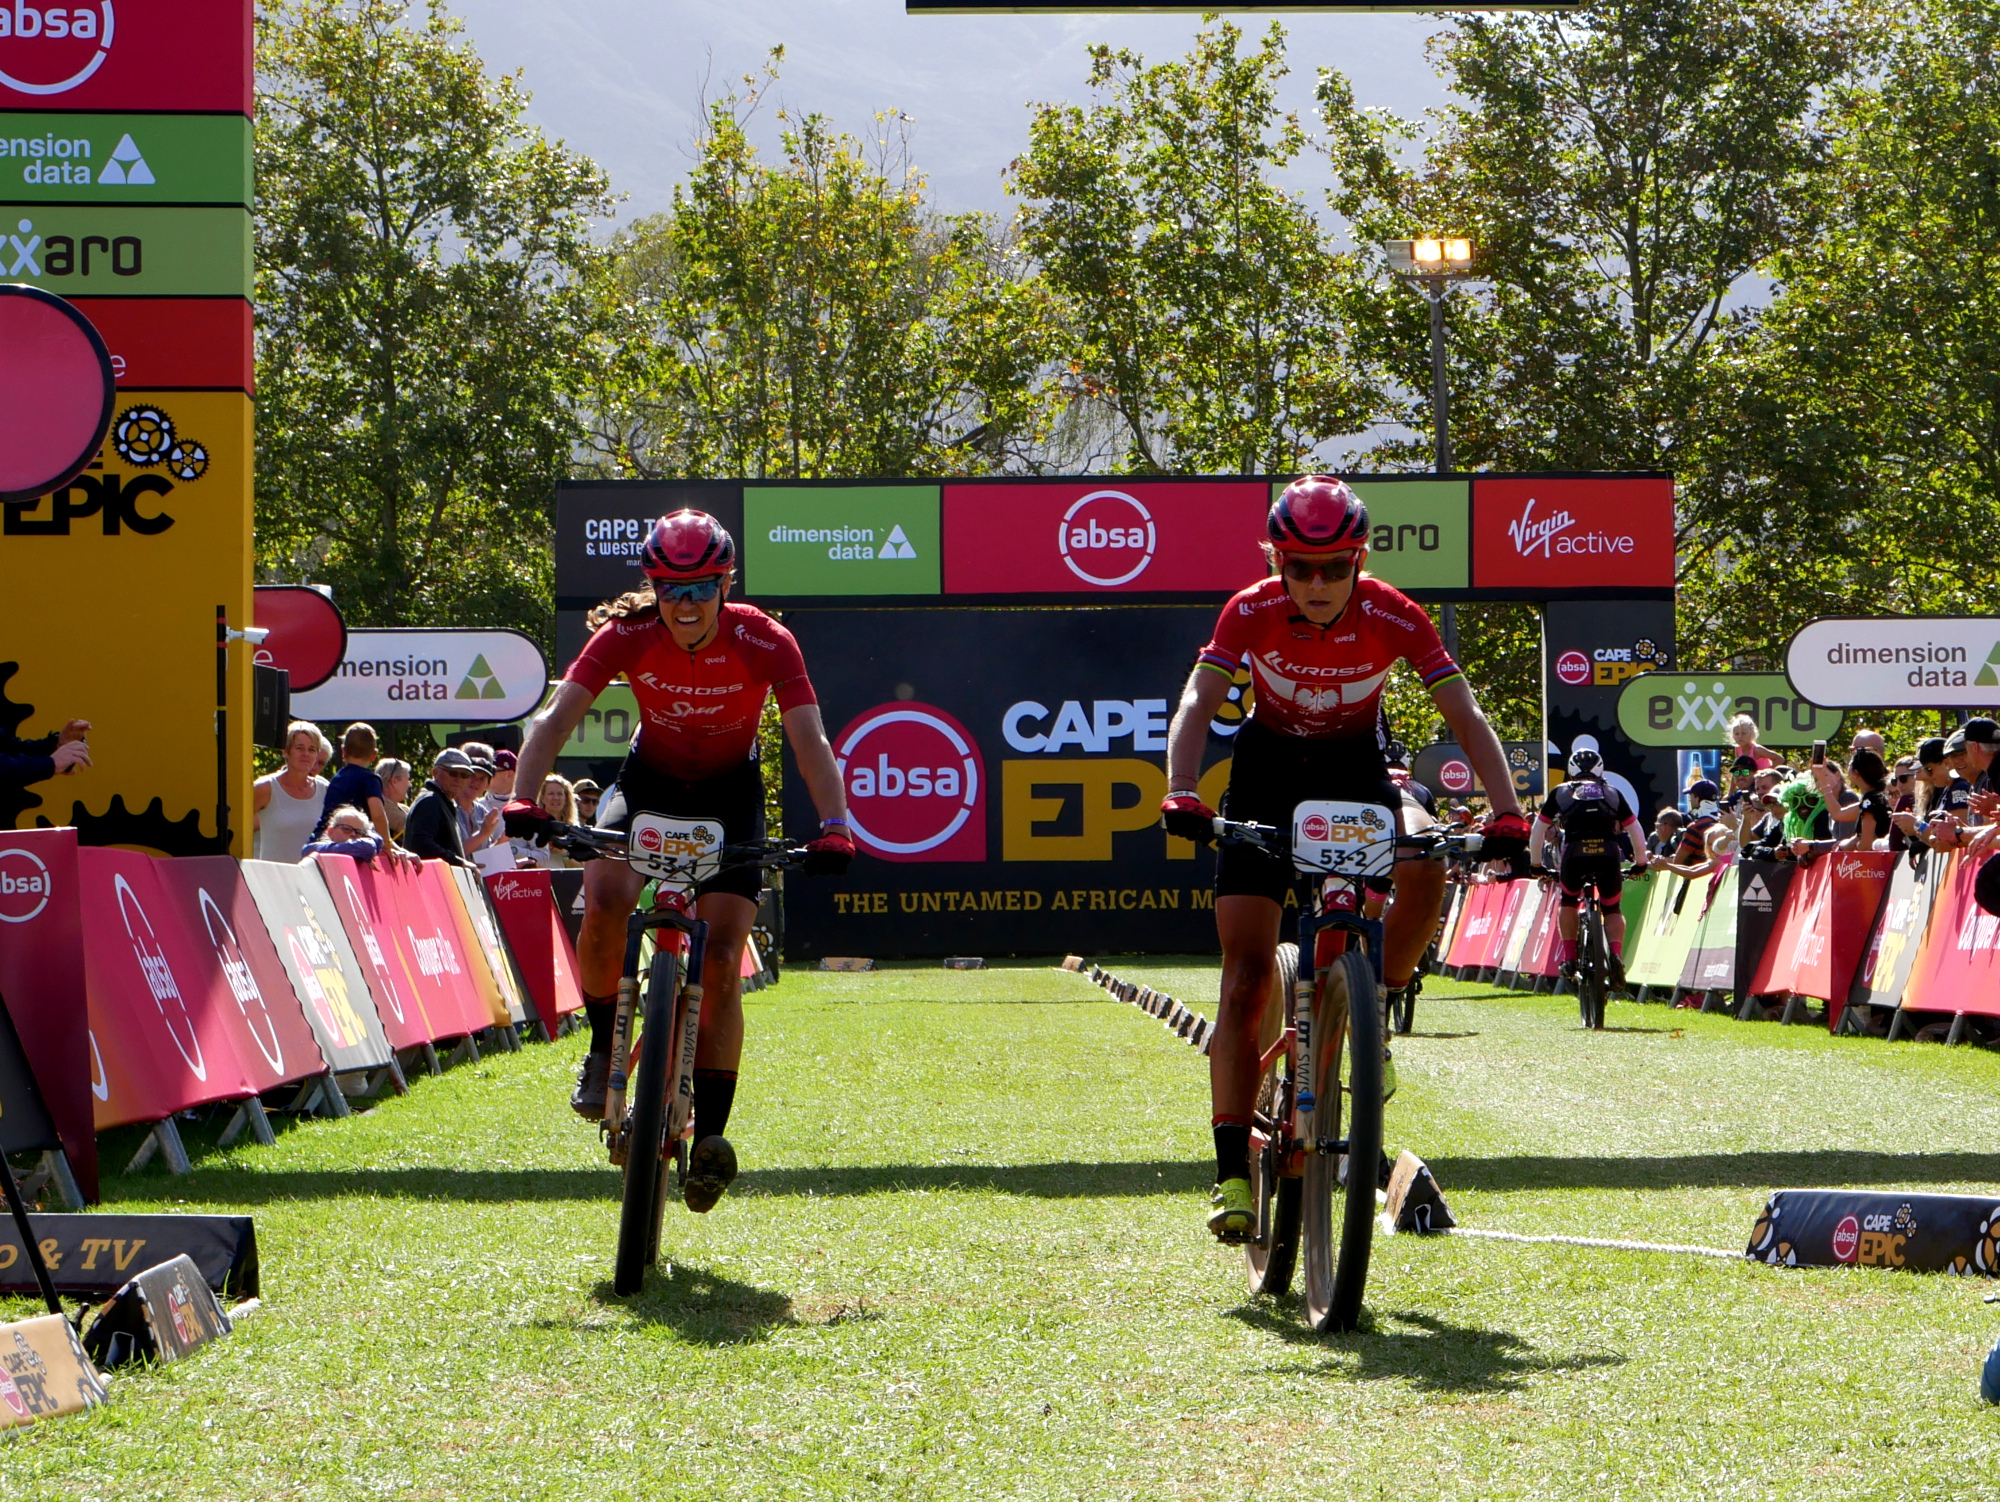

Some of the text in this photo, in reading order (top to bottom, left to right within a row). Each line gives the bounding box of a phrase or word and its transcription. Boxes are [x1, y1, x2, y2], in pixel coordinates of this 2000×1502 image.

[23, 160, 91, 184] data
[768, 524, 874, 543] dimension
[1070, 518, 1146, 549] absa
[1508, 498, 1634, 558] Virgin active
[586, 542, 596, 556] &
[828, 543, 874, 560] data
[1372, 607, 1418, 632] KROSS
[1593, 648, 1632, 662] CAPE
[1826, 642, 1967, 665] dimension
[1284, 661, 1374, 677] KROSS
[1560, 661, 1586, 672] absa
[1907, 666, 1968, 688] data
[387, 679, 448, 701] data
[659, 681, 744, 696] KROSS
[1001, 698, 1167, 753] CAPE
[1443, 769, 1468, 780] absa
[850, 753, 1232, 862] absa EP
[1331, 815, 1359, 826] CAPE
[665, 830, 691, 841] CAPE
[1305, 822, 1377, 844] absa EPIC
[641, 834, 708, 857] absa EPIC
[1319, 849, 1368, 867] 53-2
[1836, 853, 1886, 880] Virgin active
[0, 871, 43, 894] bsa
[494, 874, 543, 900] Virgin active
[834, 892, 888, 914] THE
[899, 890, 1042, 913] UNTAMED
[1051, 888, 1181, 911] AFRICAN
[615, 1014, 628, 1039] DT
[1297, 1021, 1311, 1049] DT
[679, 1074, 692, 1097] DT
[1863, 1214, 1893, 1232] CAPE
[38, 1238, 63, 1270] &
[80, 1239, 147, 1271] TV
[1836, 1227, 1907, 1266] absa EPIC
[13, 1372, 59, 1414] EPIC
